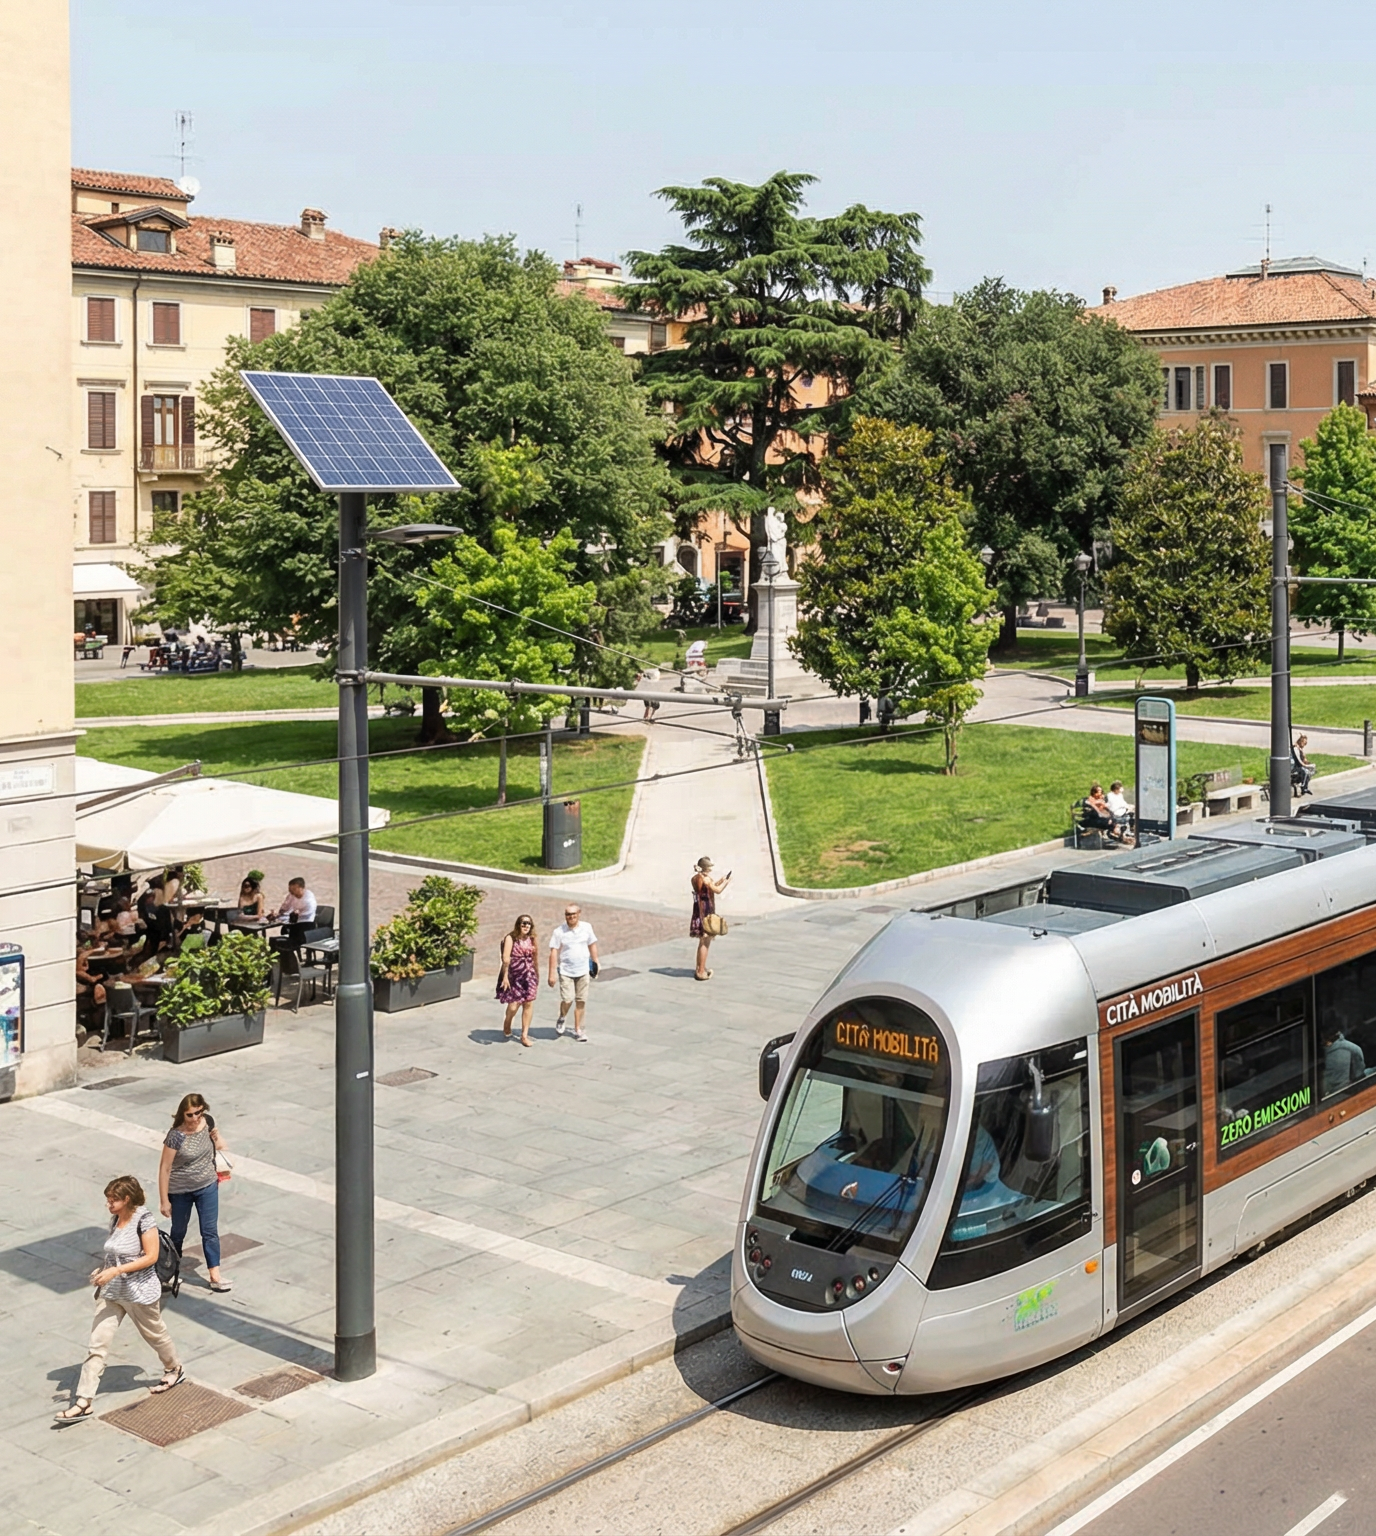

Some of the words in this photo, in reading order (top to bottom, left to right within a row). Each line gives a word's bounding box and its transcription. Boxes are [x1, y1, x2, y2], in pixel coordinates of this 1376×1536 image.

[1106, 993, 1140, 1026] CITÀ
[1141, 971, 1204, 1014] MOBILITÀ
[1220, 1115, 1252, 1146] ZERO
[1253, 1086, 1311, 1130] EMISSIONI
